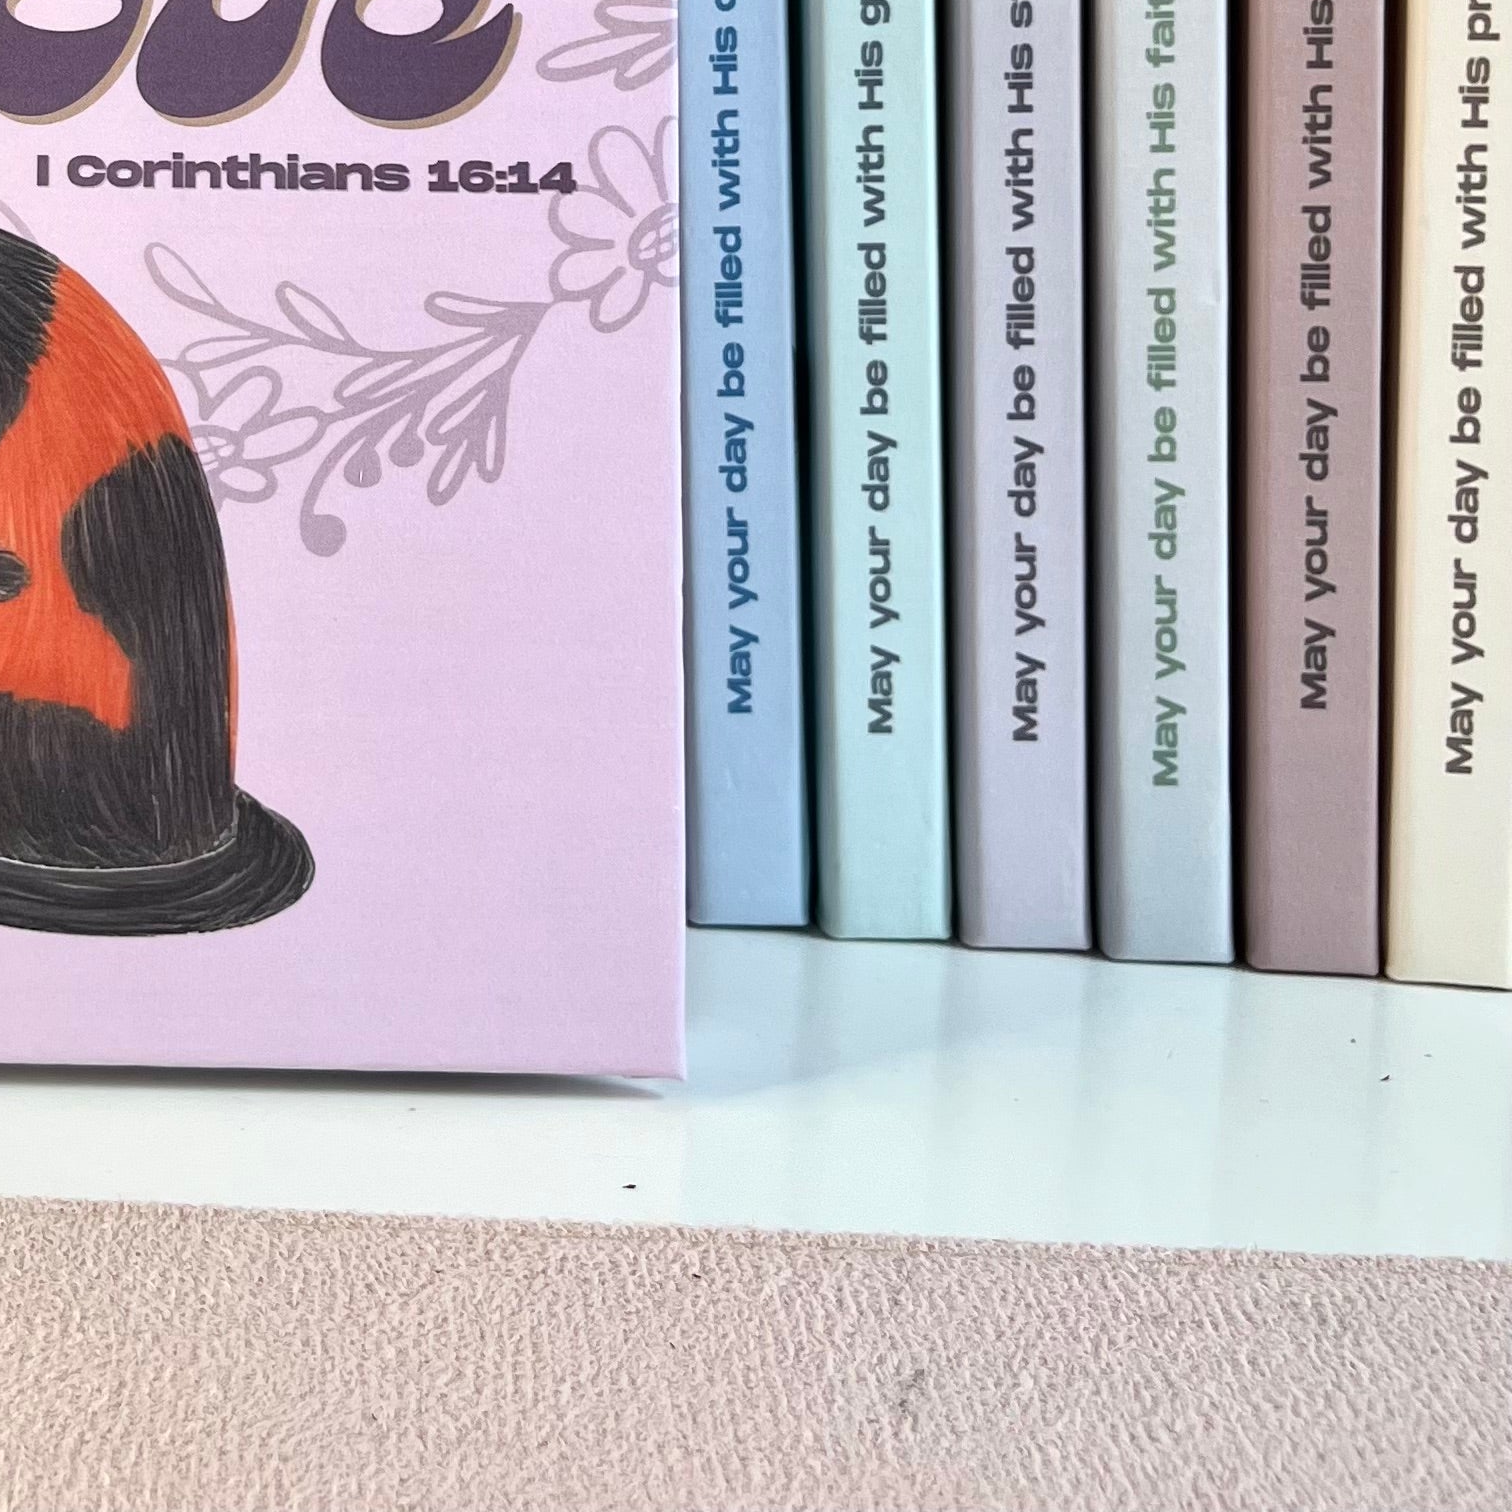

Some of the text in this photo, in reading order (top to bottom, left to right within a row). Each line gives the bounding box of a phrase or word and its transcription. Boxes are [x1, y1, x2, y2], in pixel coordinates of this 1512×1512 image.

[708, 26, 738, 95] His
[854, 40, 884, 110] His
[1004, 43, 1034, 113] His
[1458, 56, 1491, 129] His
[711, 109, 741, 212] with
[1146, 83, 1176, 153] His
[1302, 84, 1333, 190] with
[66, 152, 411, 192] Corinthians
[426, 159, 578, 196] 16:14
[855, 125, 886, 227] with
[1004, 128, 1035, 232] with
[1455, 143, 1488, 250] with
[1146, 168, 1176, 272] with
[1300, 205, 1332, 311] filled
[713, 226, 744, 328] filled
[857, 242, 888, 345] filled
[1005, 247, 1036, 350] filled
[1450, 265, 1485, 372] filled
[717, 342, 745, 397] be
[1147, 288, 1176, 392] filled
[1300, 326, 1330, 383] be
[860, 359, 889, 415] be
[1006, 364, 1036, 421] be
[1449, 386, 1482, 445] be
[718, 412, 754, 493] day
[861, 430, 898, 512] day
[1007, 436, 1045, 518] day
[1147, 407, 1177, 462] be
[1298, 398, 1338, 481] day
[1148, 477, 1185, 560] day
[1447, 458, 1489, 544] day
[726, 506, 759, 610] your
[868, 525, 900, 629] your
[1014, 532, 1046, 636] your
[1304, 495, 1337, 602] your
[1155, 574, 1186, 680] your
[1451, 557, 1485, 665] your
[727, 624, 760, 714] May
[868, 645, 901, 734] May
[1012, 651, 1047, 742] May
[1300, 618, 1336, 710] May
[1152, 696, 1187, 786] May
[1445, 681, 1484, 775] May
